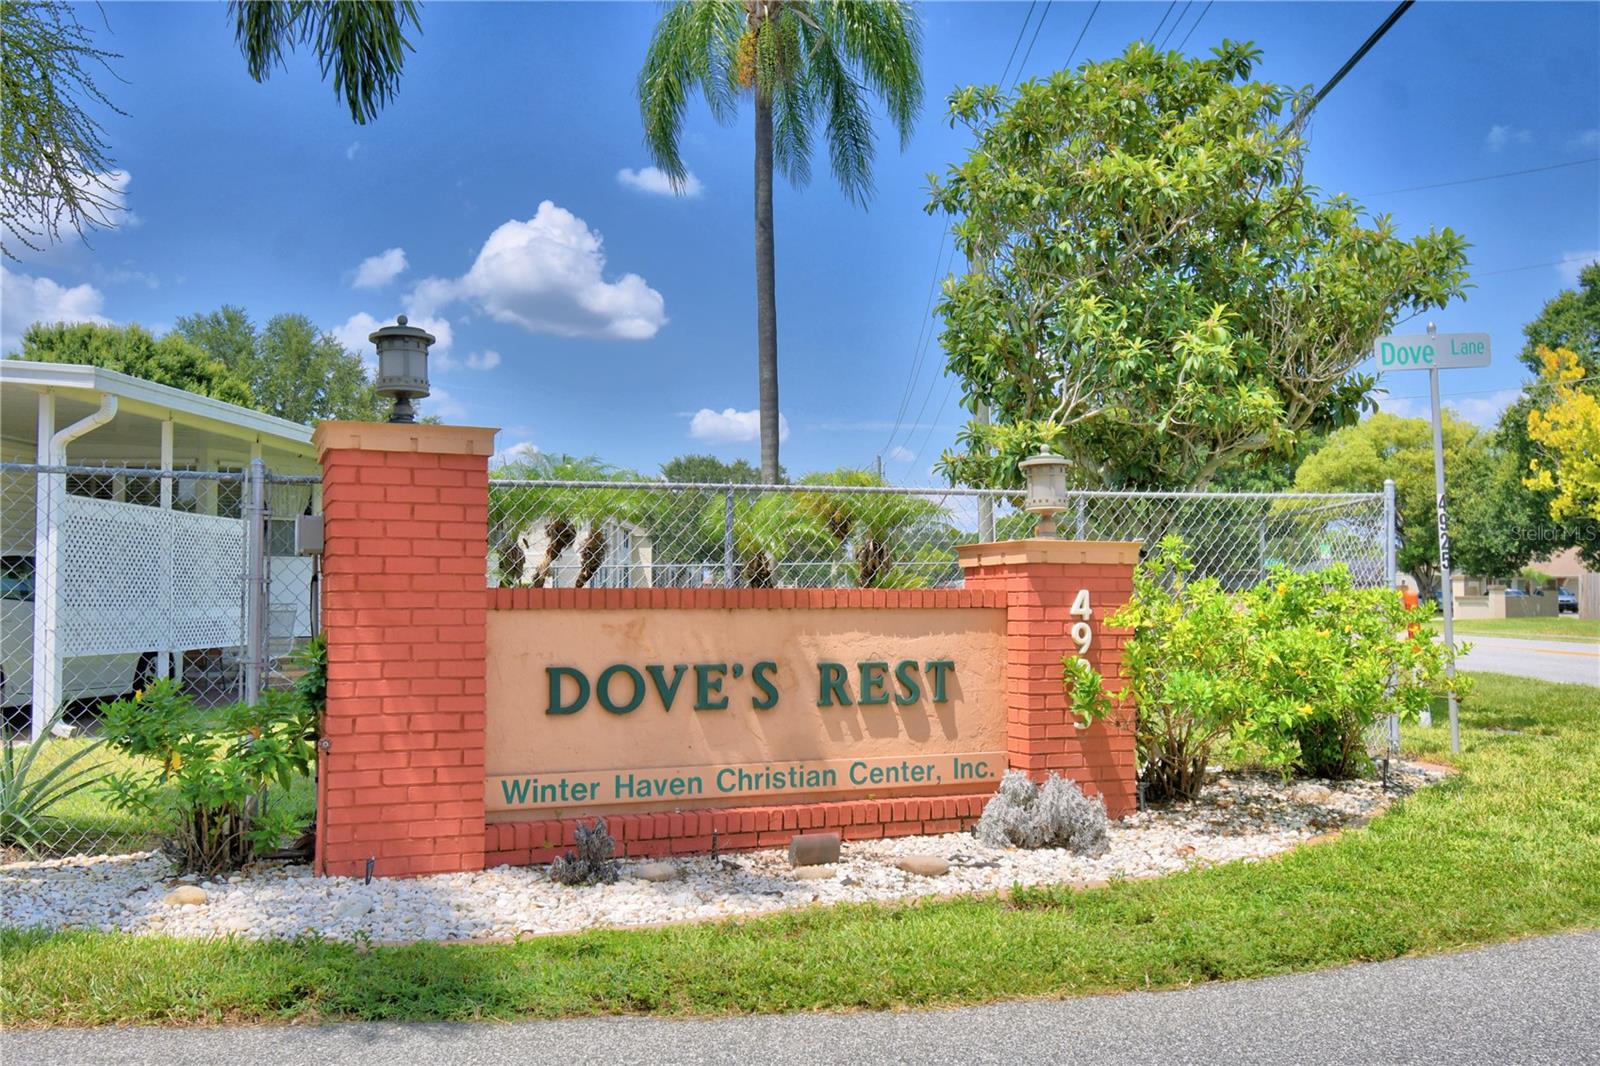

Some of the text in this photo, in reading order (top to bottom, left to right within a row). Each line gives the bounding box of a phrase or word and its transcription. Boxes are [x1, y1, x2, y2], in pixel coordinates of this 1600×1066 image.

[1381, 340, 1485, 365] Dove Lane
[1438, 494, 1450, 570] 4925
[545, 659, 956, 716] DOVE'S REST
[501, 757, 995, 805] Winter Haven Christian Center, Inc.
